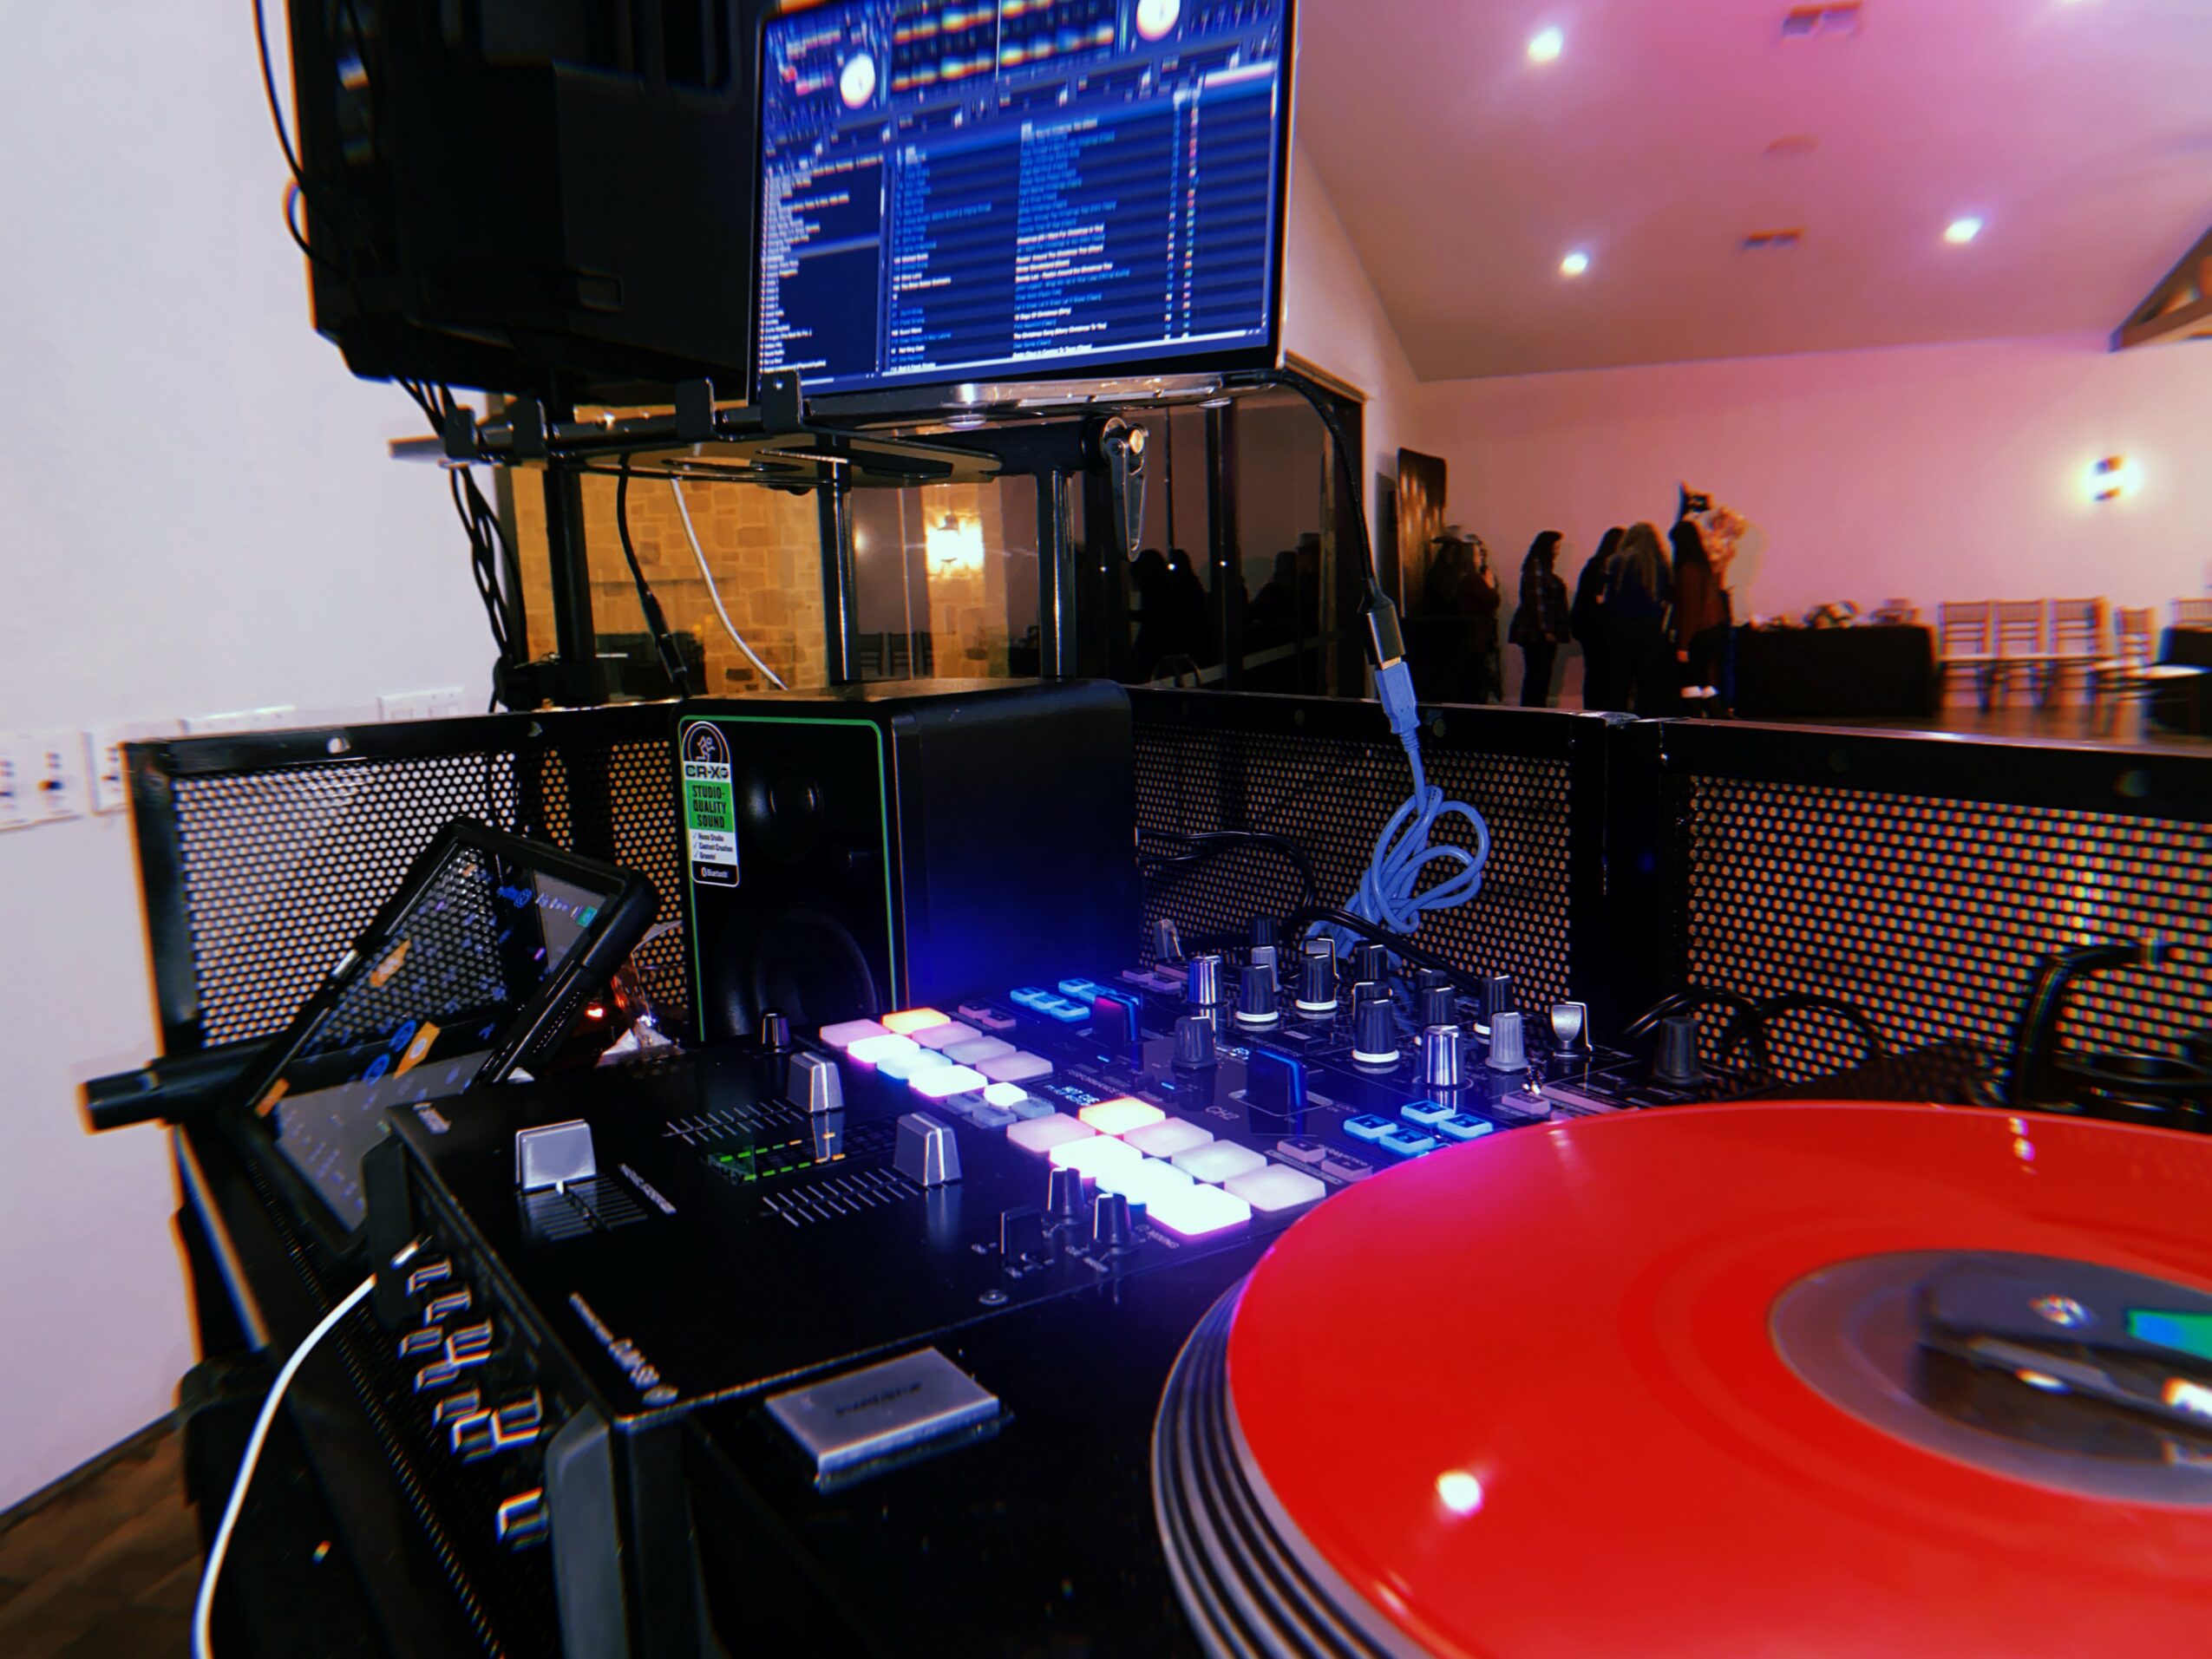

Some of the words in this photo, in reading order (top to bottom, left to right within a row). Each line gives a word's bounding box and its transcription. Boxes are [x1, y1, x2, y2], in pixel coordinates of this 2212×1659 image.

[692, 784, 725, 799] STUDIO-
[693, 799, 727, 814] QUALITY
[697, 815, 725, 829] SOUND
